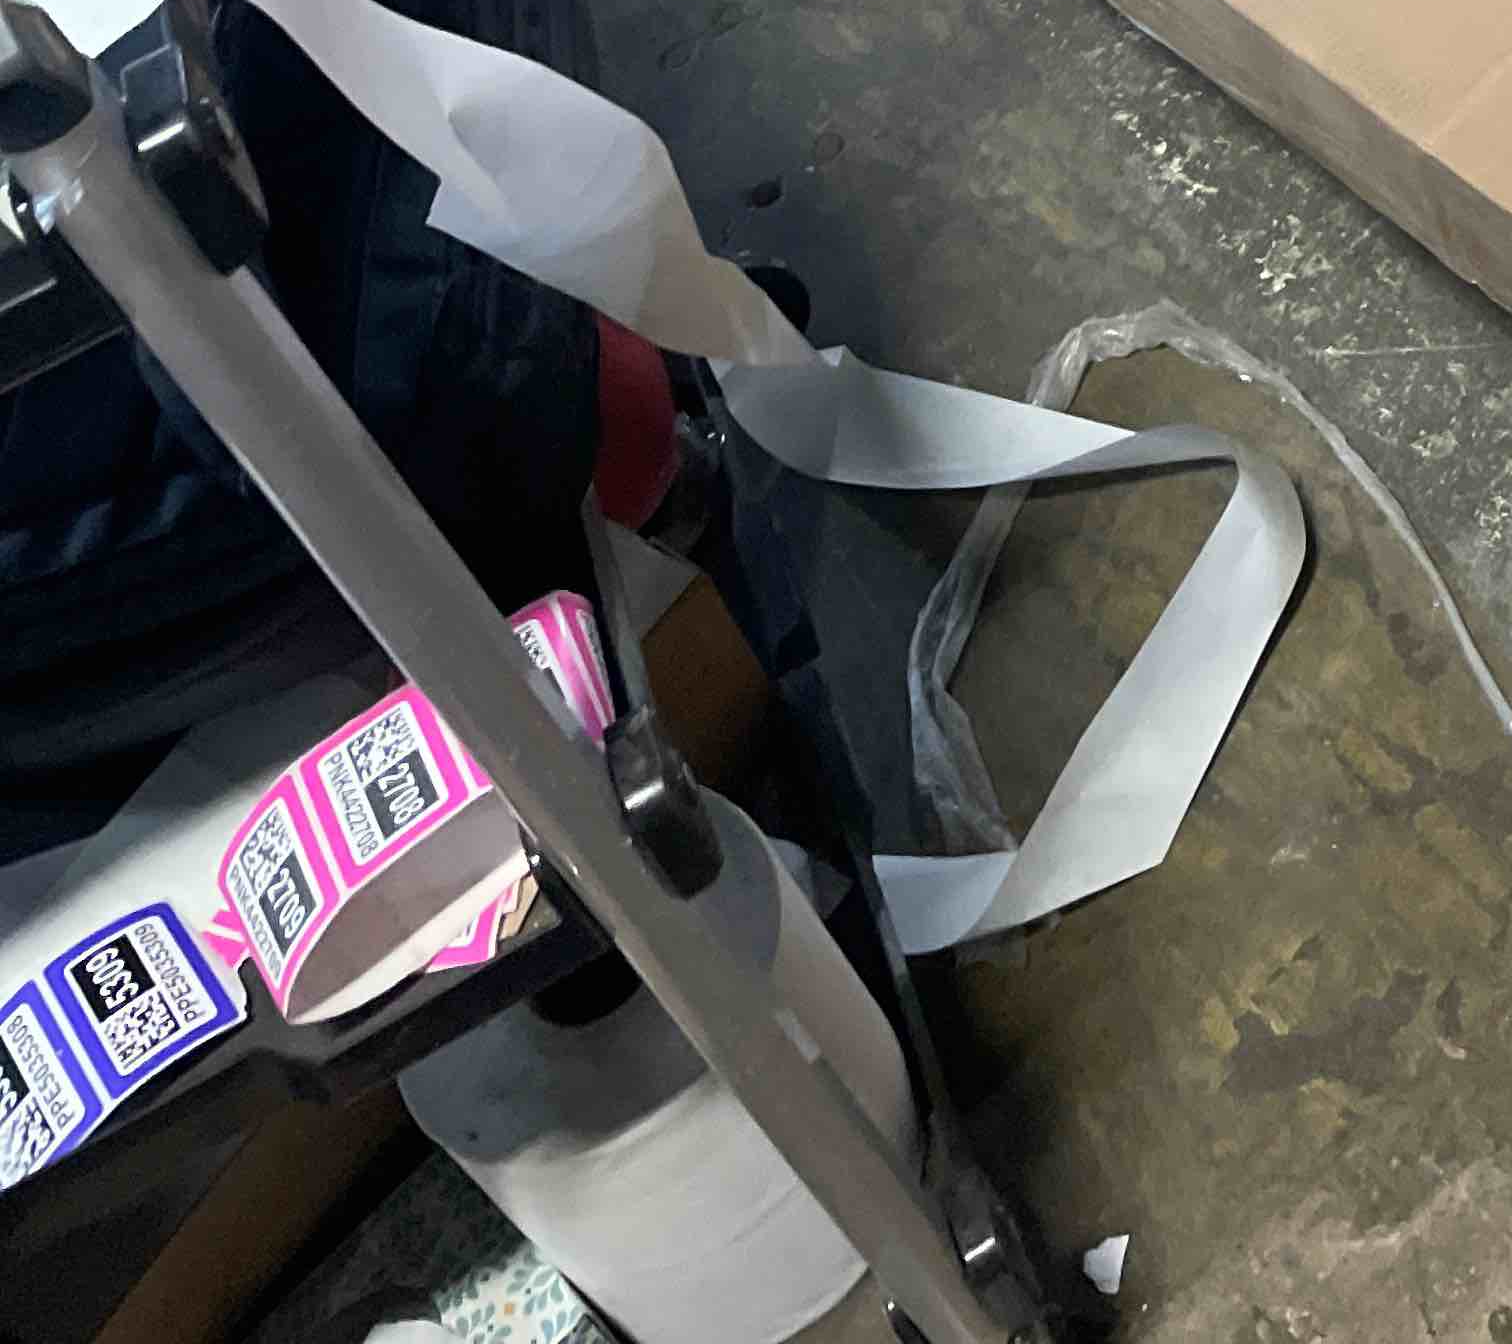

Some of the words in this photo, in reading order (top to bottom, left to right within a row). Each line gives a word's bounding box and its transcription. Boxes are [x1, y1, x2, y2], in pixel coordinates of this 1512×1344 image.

[327, 752, 379, 858] PNK4422708
[377, 762, 424, 825] 2708
[267, 868, 306, 939] 2709
[85, 947, 138, 1009] 5309
[134, 923, 201, 1022] PPE5035309
[6, 1015, 75, 1128] PPE5035308
